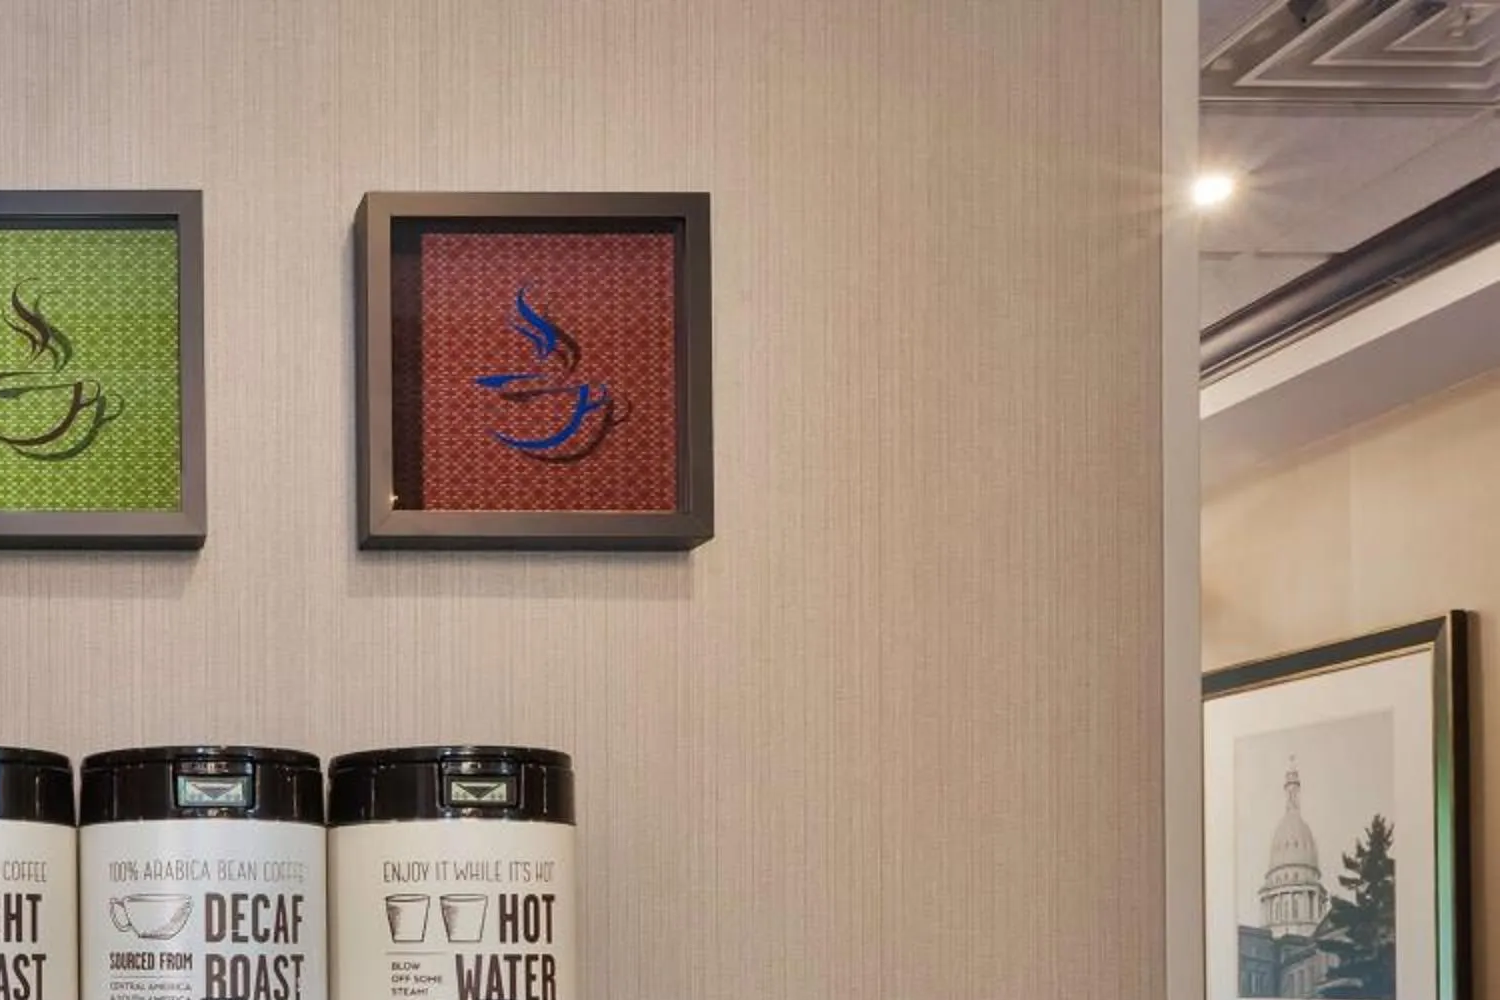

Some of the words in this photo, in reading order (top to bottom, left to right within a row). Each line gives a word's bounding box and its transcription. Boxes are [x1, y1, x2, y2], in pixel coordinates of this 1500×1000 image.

[3, 861, 47, 883] COFFEE
[109, 860, 138, 882] 100%
[143, 859, 211, 881] ARABICA
[217, 859, 257, 881] BEAN
[383, 861, 429, 883] ENJOY
[435, 861, 448, 882] IT
[453, 860, 503, 882] WHILE
[509, 861, 531, 882] IT'S
[204, 892, 304, 944] DECAF
[498, 893, 556, 944] HOT
[109, 952, 155, 970] SOURCED
[159, 952, 193, 970] FROM
[391, 962, 421, 971] BLOW
[413, 975, 443, 984] SOME
